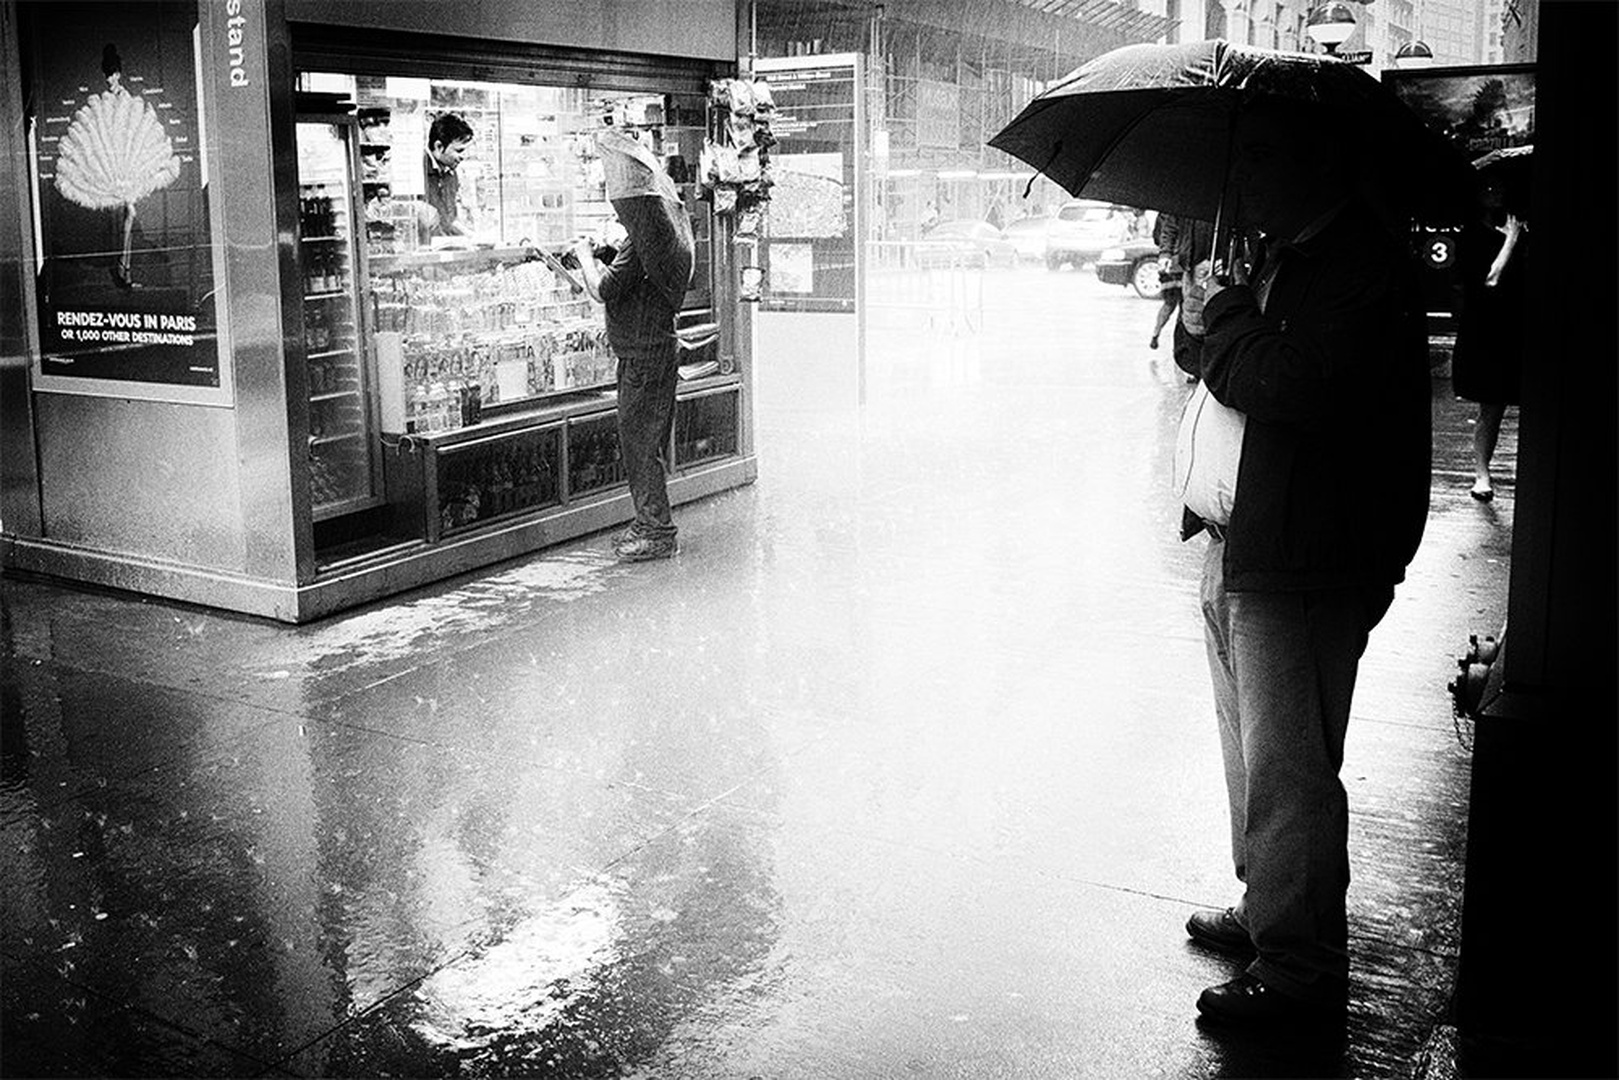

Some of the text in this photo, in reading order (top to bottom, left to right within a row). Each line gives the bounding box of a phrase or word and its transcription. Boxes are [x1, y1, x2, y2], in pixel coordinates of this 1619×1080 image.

[226, 0, 249, 87] stand
[1431, 241, 1448, 263] 3
[57, 311, 196, 331] RENDEZ-VOUS IN PARIS
[61, 329, 194, 346] OR 1,000 OTHER DESTINATIONS
